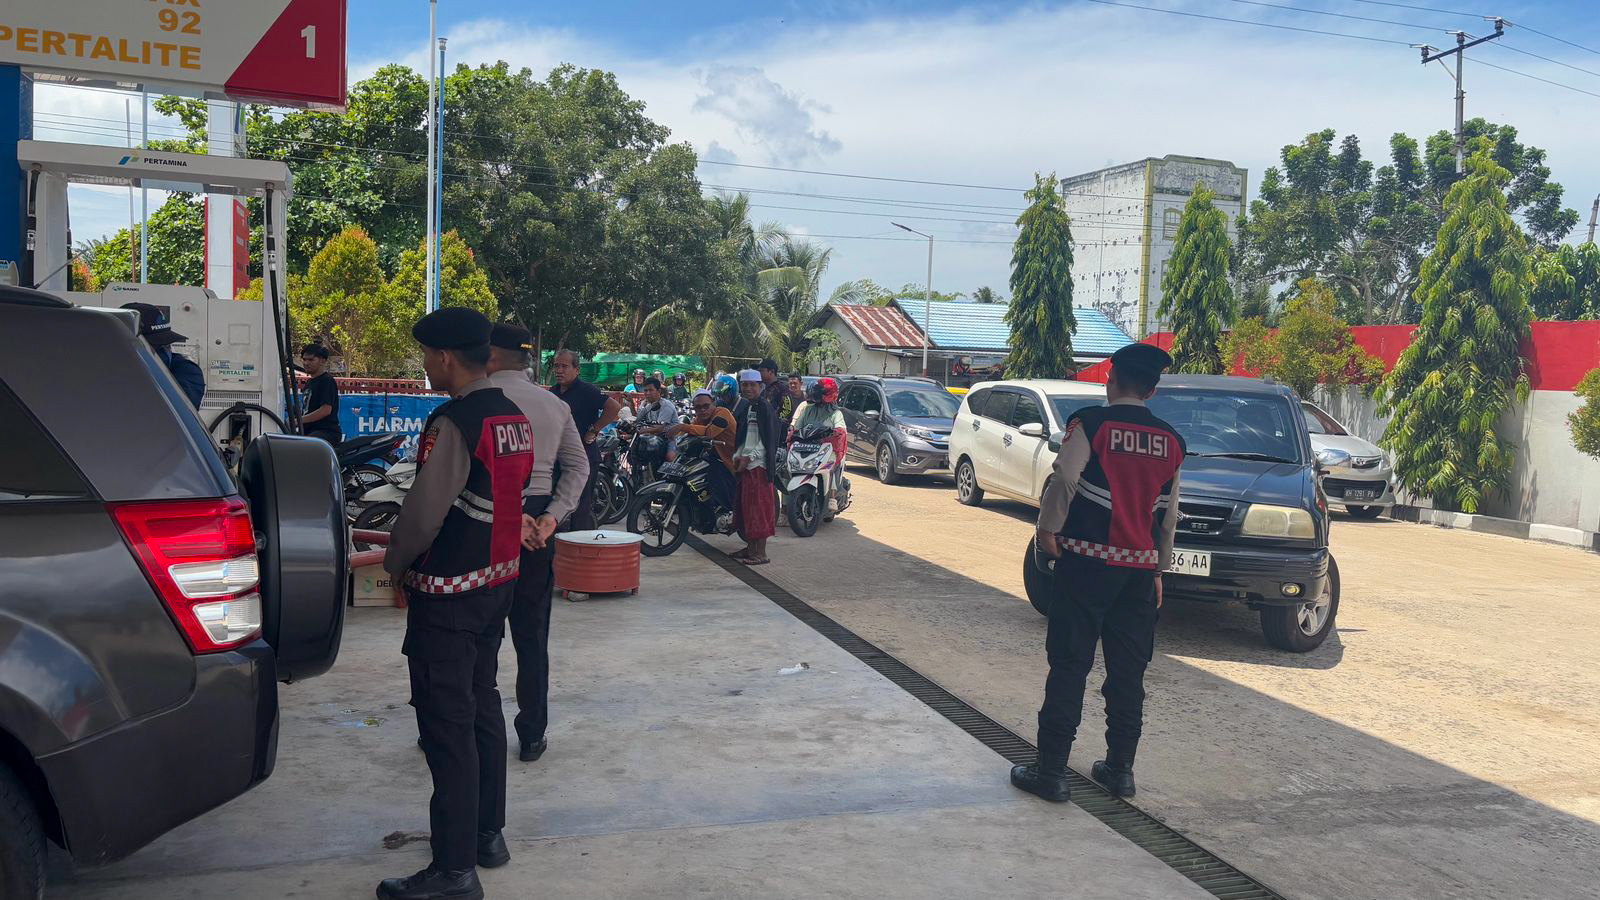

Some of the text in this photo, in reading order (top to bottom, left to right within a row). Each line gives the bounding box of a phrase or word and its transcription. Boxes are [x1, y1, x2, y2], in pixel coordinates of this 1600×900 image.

[158, 8, 201, 34] 92
[0, 24, 201, 69] PERTALITE
[301, 25, 315, 58] 1
[143, 157, 187, 166] PERTAMINA
[358, 416, 425, 432] HARM
[495, 423, 532, 454] POLISI
[1110, 429, 1168, 457] POLISI
[1191, 554, 1207, 568] AA
